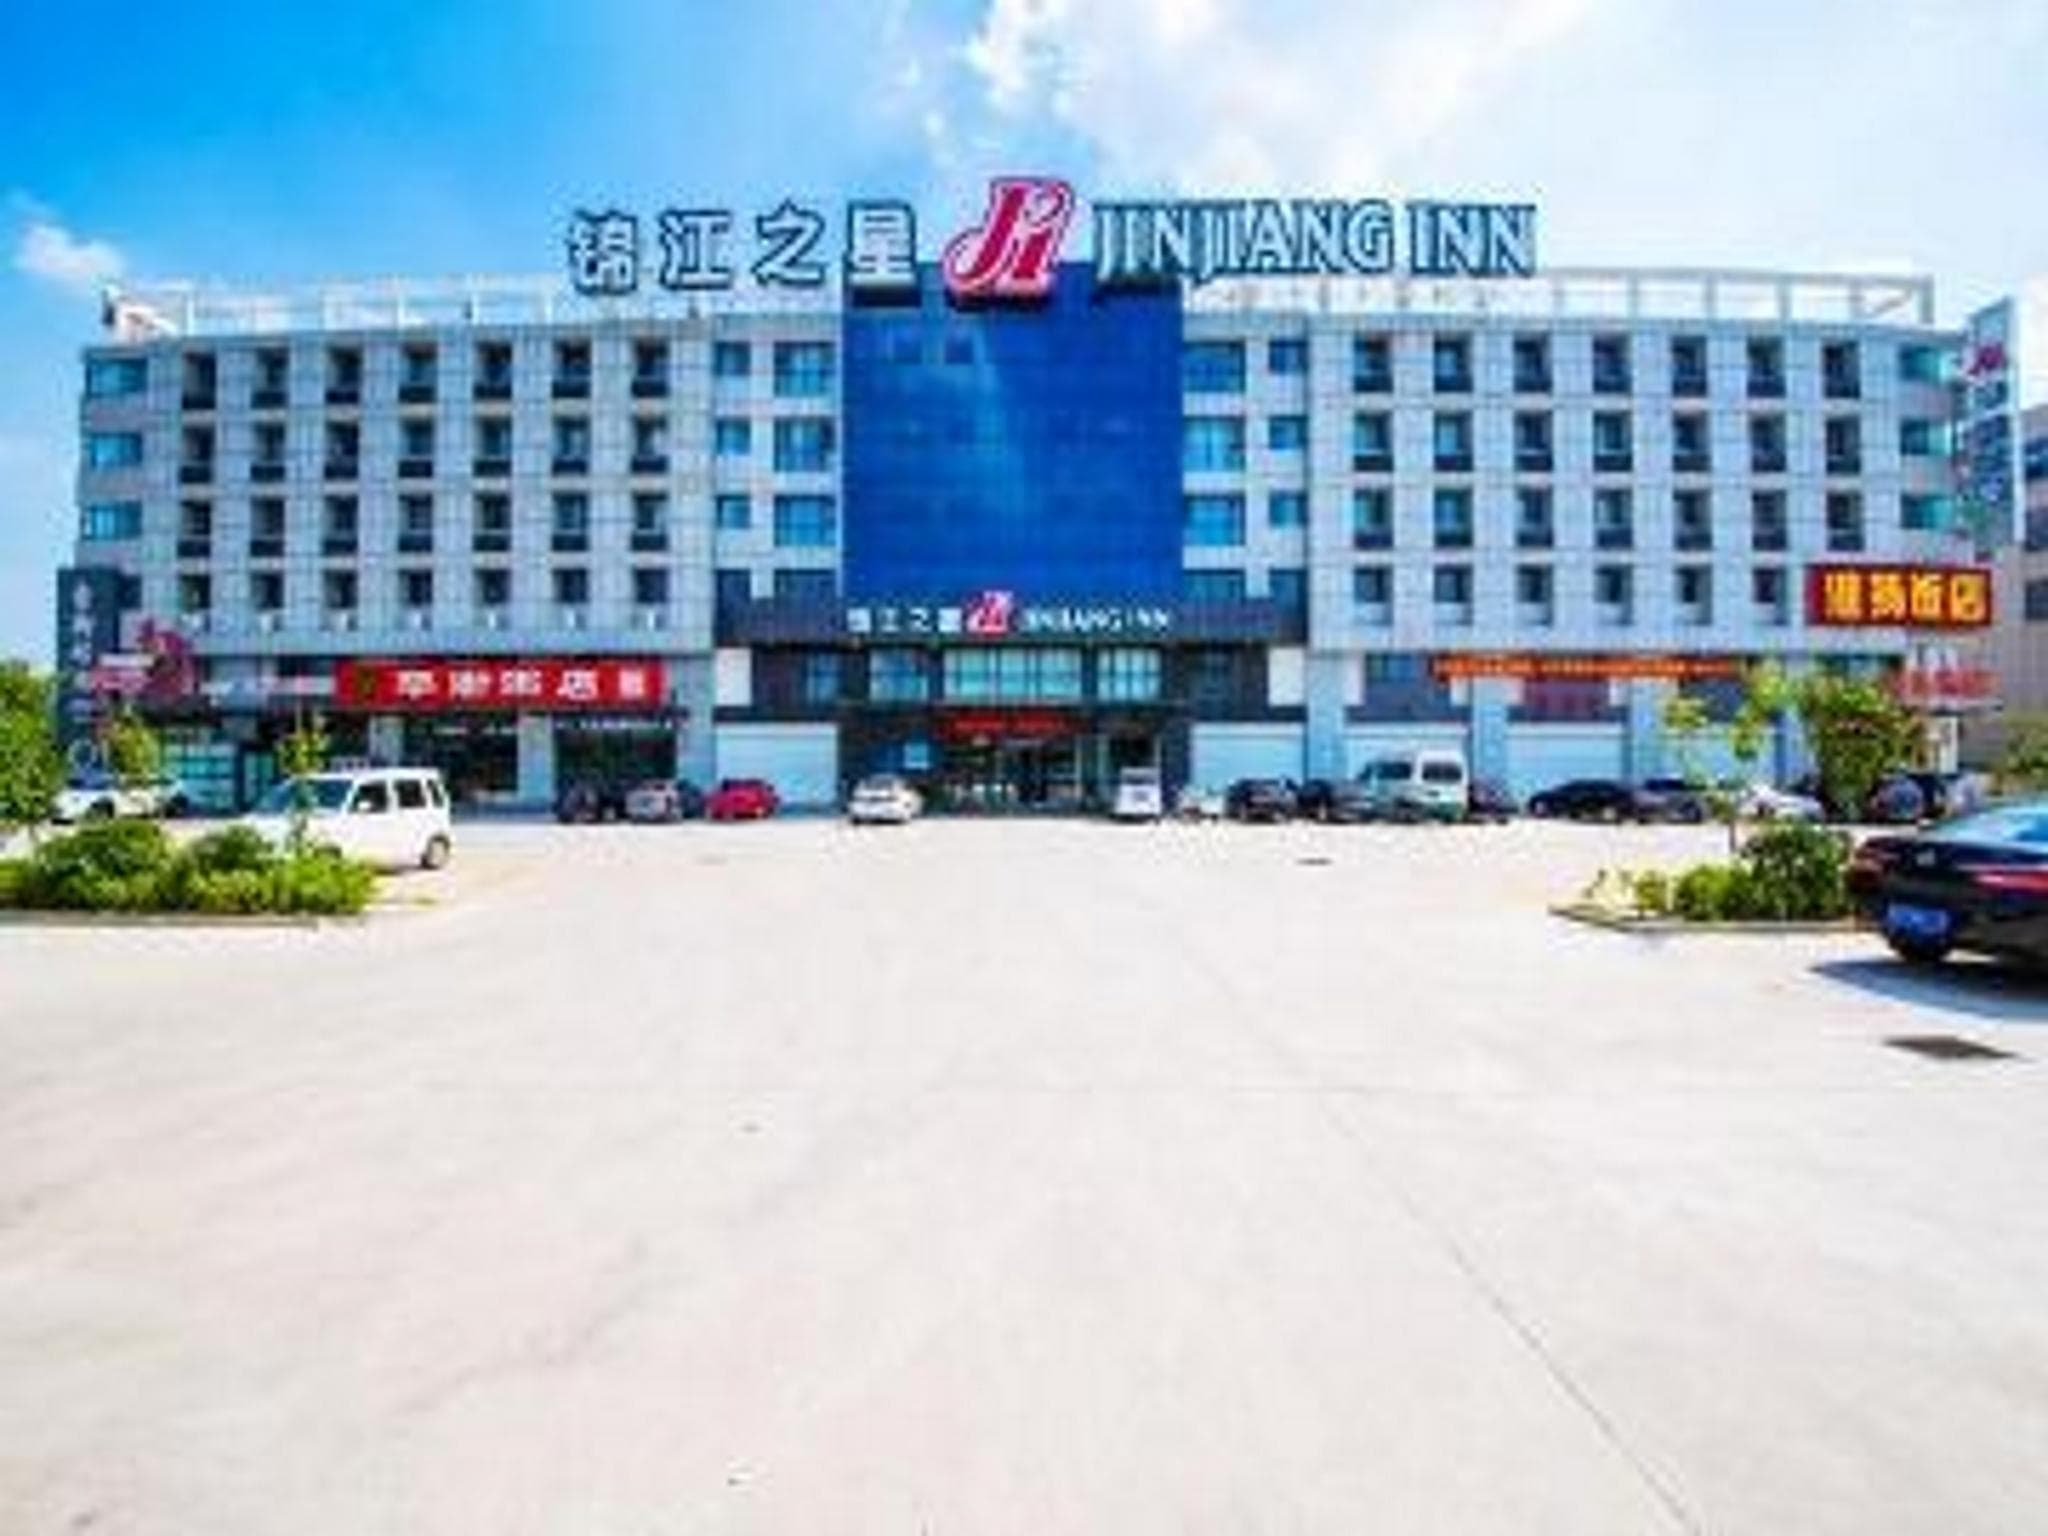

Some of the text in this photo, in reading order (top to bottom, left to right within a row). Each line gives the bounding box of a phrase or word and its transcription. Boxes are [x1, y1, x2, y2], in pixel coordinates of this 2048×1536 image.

[568, 199, 917, 295] 锦江之星
[1093, 199, 1398, 286] JINJIANG
[1404, 202, 1536, 277] INN
